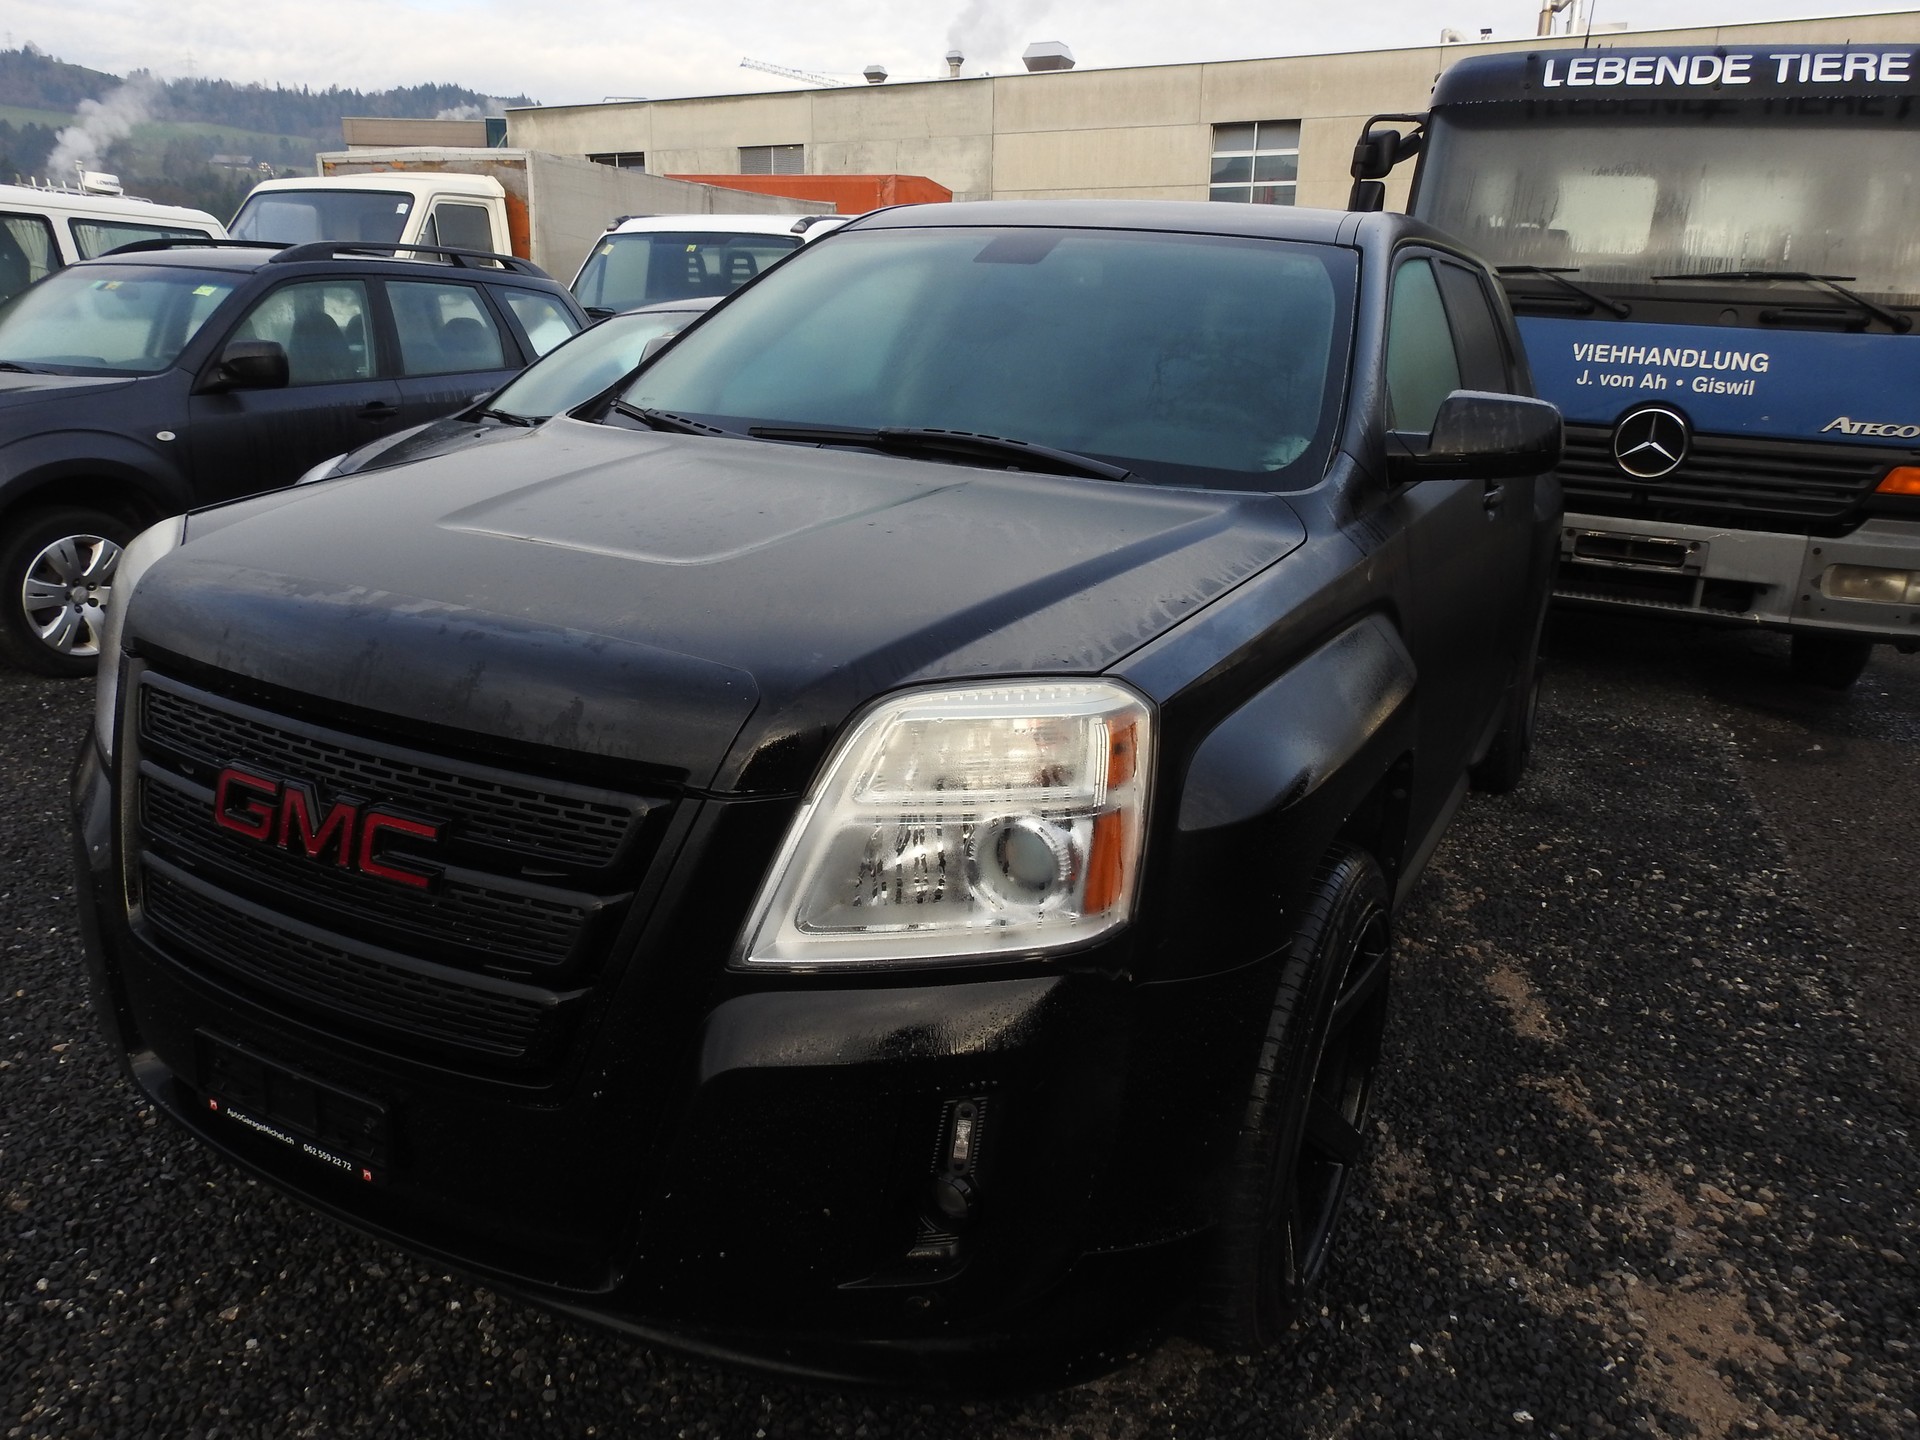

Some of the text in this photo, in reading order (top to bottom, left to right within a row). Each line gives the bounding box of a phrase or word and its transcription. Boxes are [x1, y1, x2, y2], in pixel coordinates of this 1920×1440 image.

[1543, 52, 1912, 87] LEBENDE TIERE
[1573, 342, 1769, 373] VIEHHANDLUNG
[1576, 370, 1756, 396] J. von Ah Giswil
[214, 765, 442, 890] GMC
[303, 1143, 317, 1156] 062
[318, 1149, 331, 1162] 559
[332, 1156, 342, 1167] 22
[342, 1160, 352, 1171] 72
